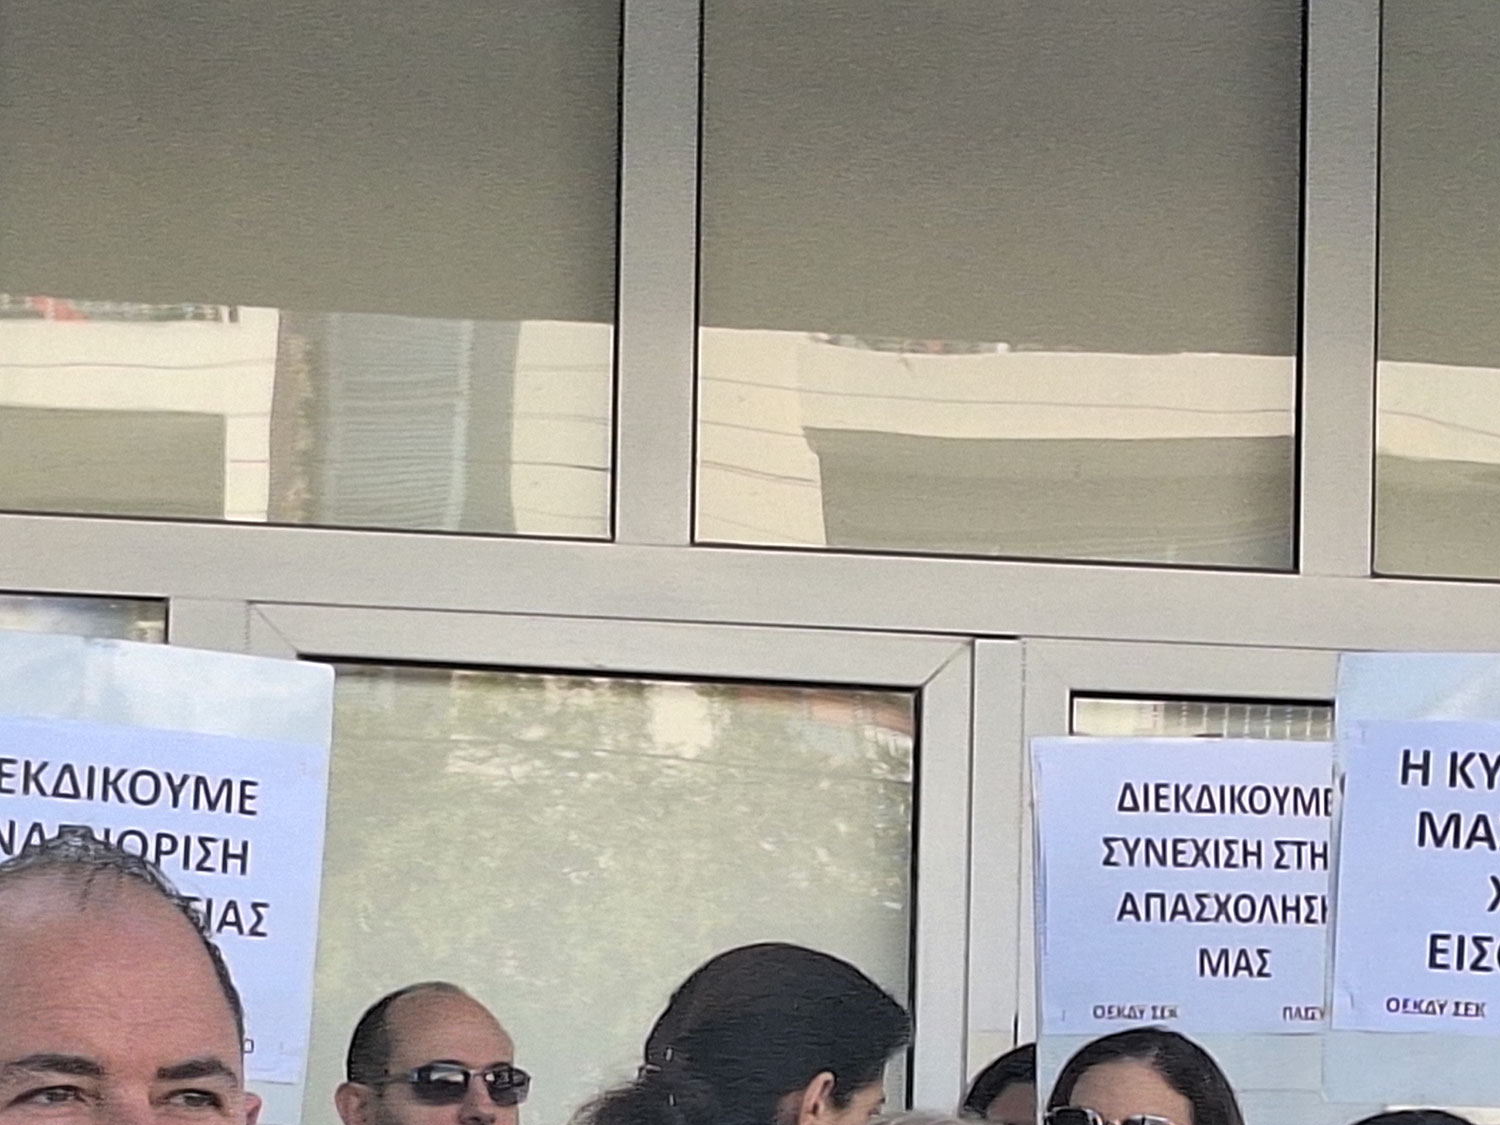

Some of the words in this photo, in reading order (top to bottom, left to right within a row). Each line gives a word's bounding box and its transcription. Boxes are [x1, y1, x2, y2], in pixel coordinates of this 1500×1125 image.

[1401, 749, 1431, 787] Η
[1102, 837, 1262, 870] ΣΥΝΕΧΙΣΗ
[1199, 948, 1272, 978] ΜΑΣ
[1386, 997, 1448, 1016] ΟΕΚΔΥ
[1452, 1001, 1485, 1018] ΣΕΚ
